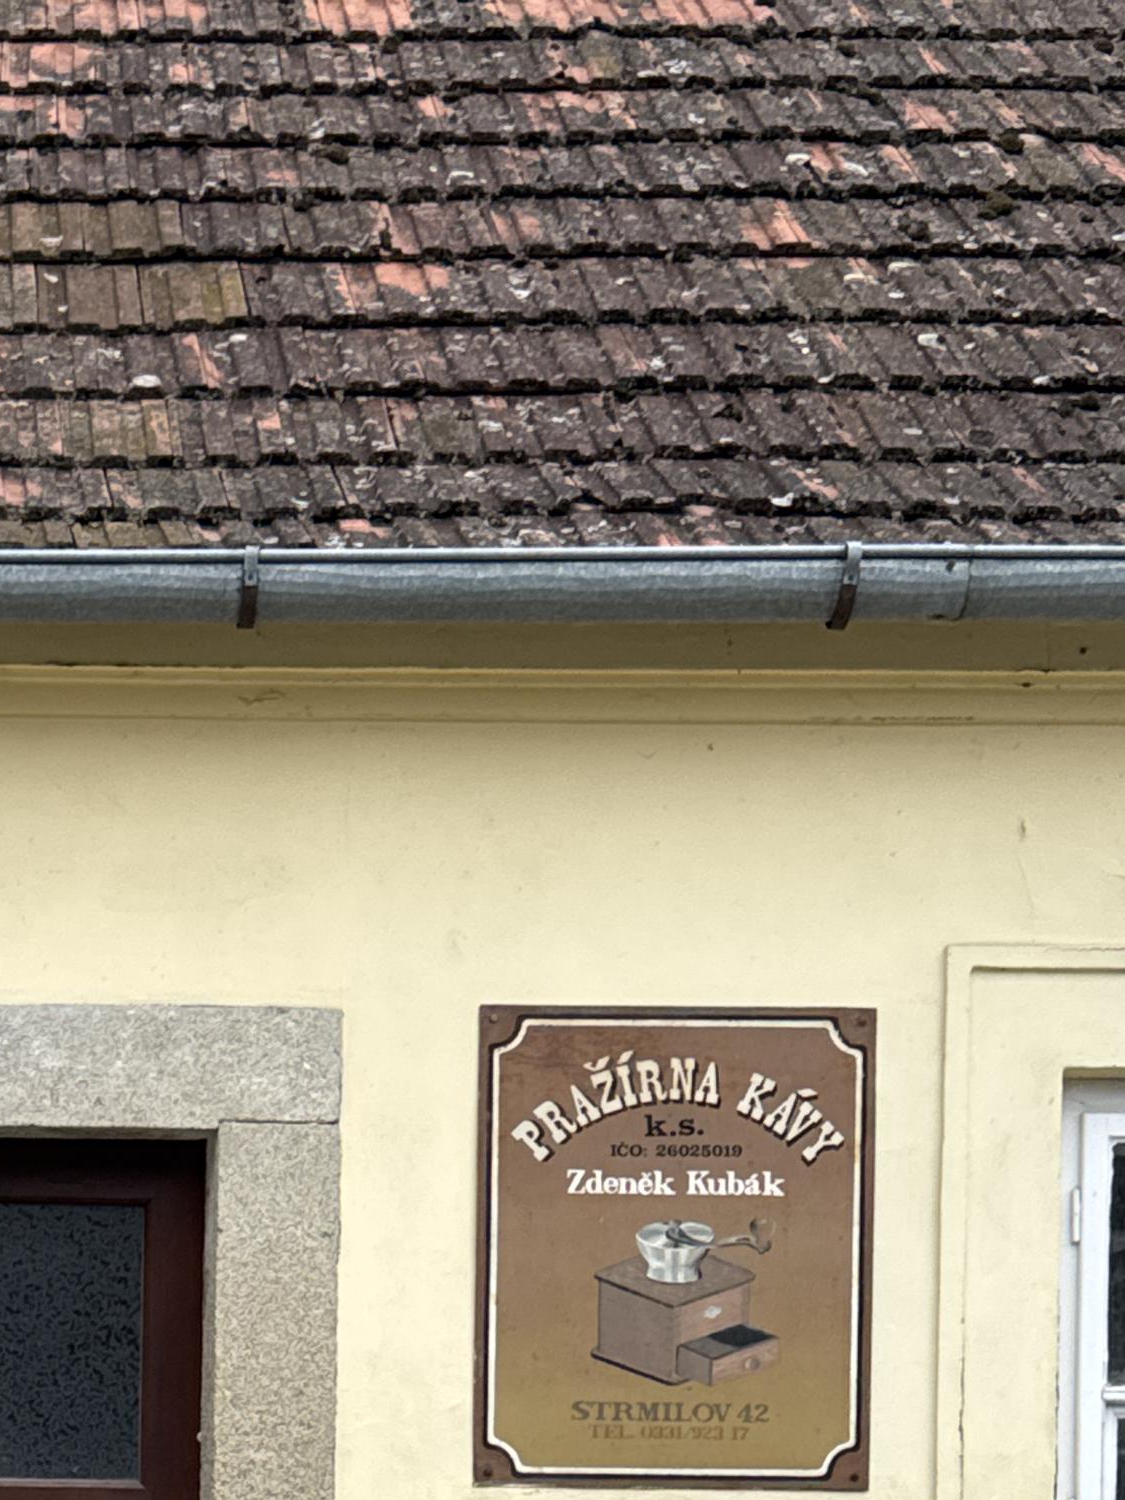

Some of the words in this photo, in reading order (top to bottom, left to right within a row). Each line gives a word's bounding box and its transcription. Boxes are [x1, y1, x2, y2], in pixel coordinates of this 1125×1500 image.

[511, 1049, 721, 1163] PRAŽÍRNA
[736, 1072, 845, 1167] KÁVY
[645, 1114, 704, 1137] k.s.
[656, 1144, 743, 1158] 26025019
[567, 1168, 676, 1195] Zdeněk
[686, 1170, 786, 1197] Kubák
[571, 1401, 731, 1423] STRMILOV
[737, 1404, 770, 1423] 42
